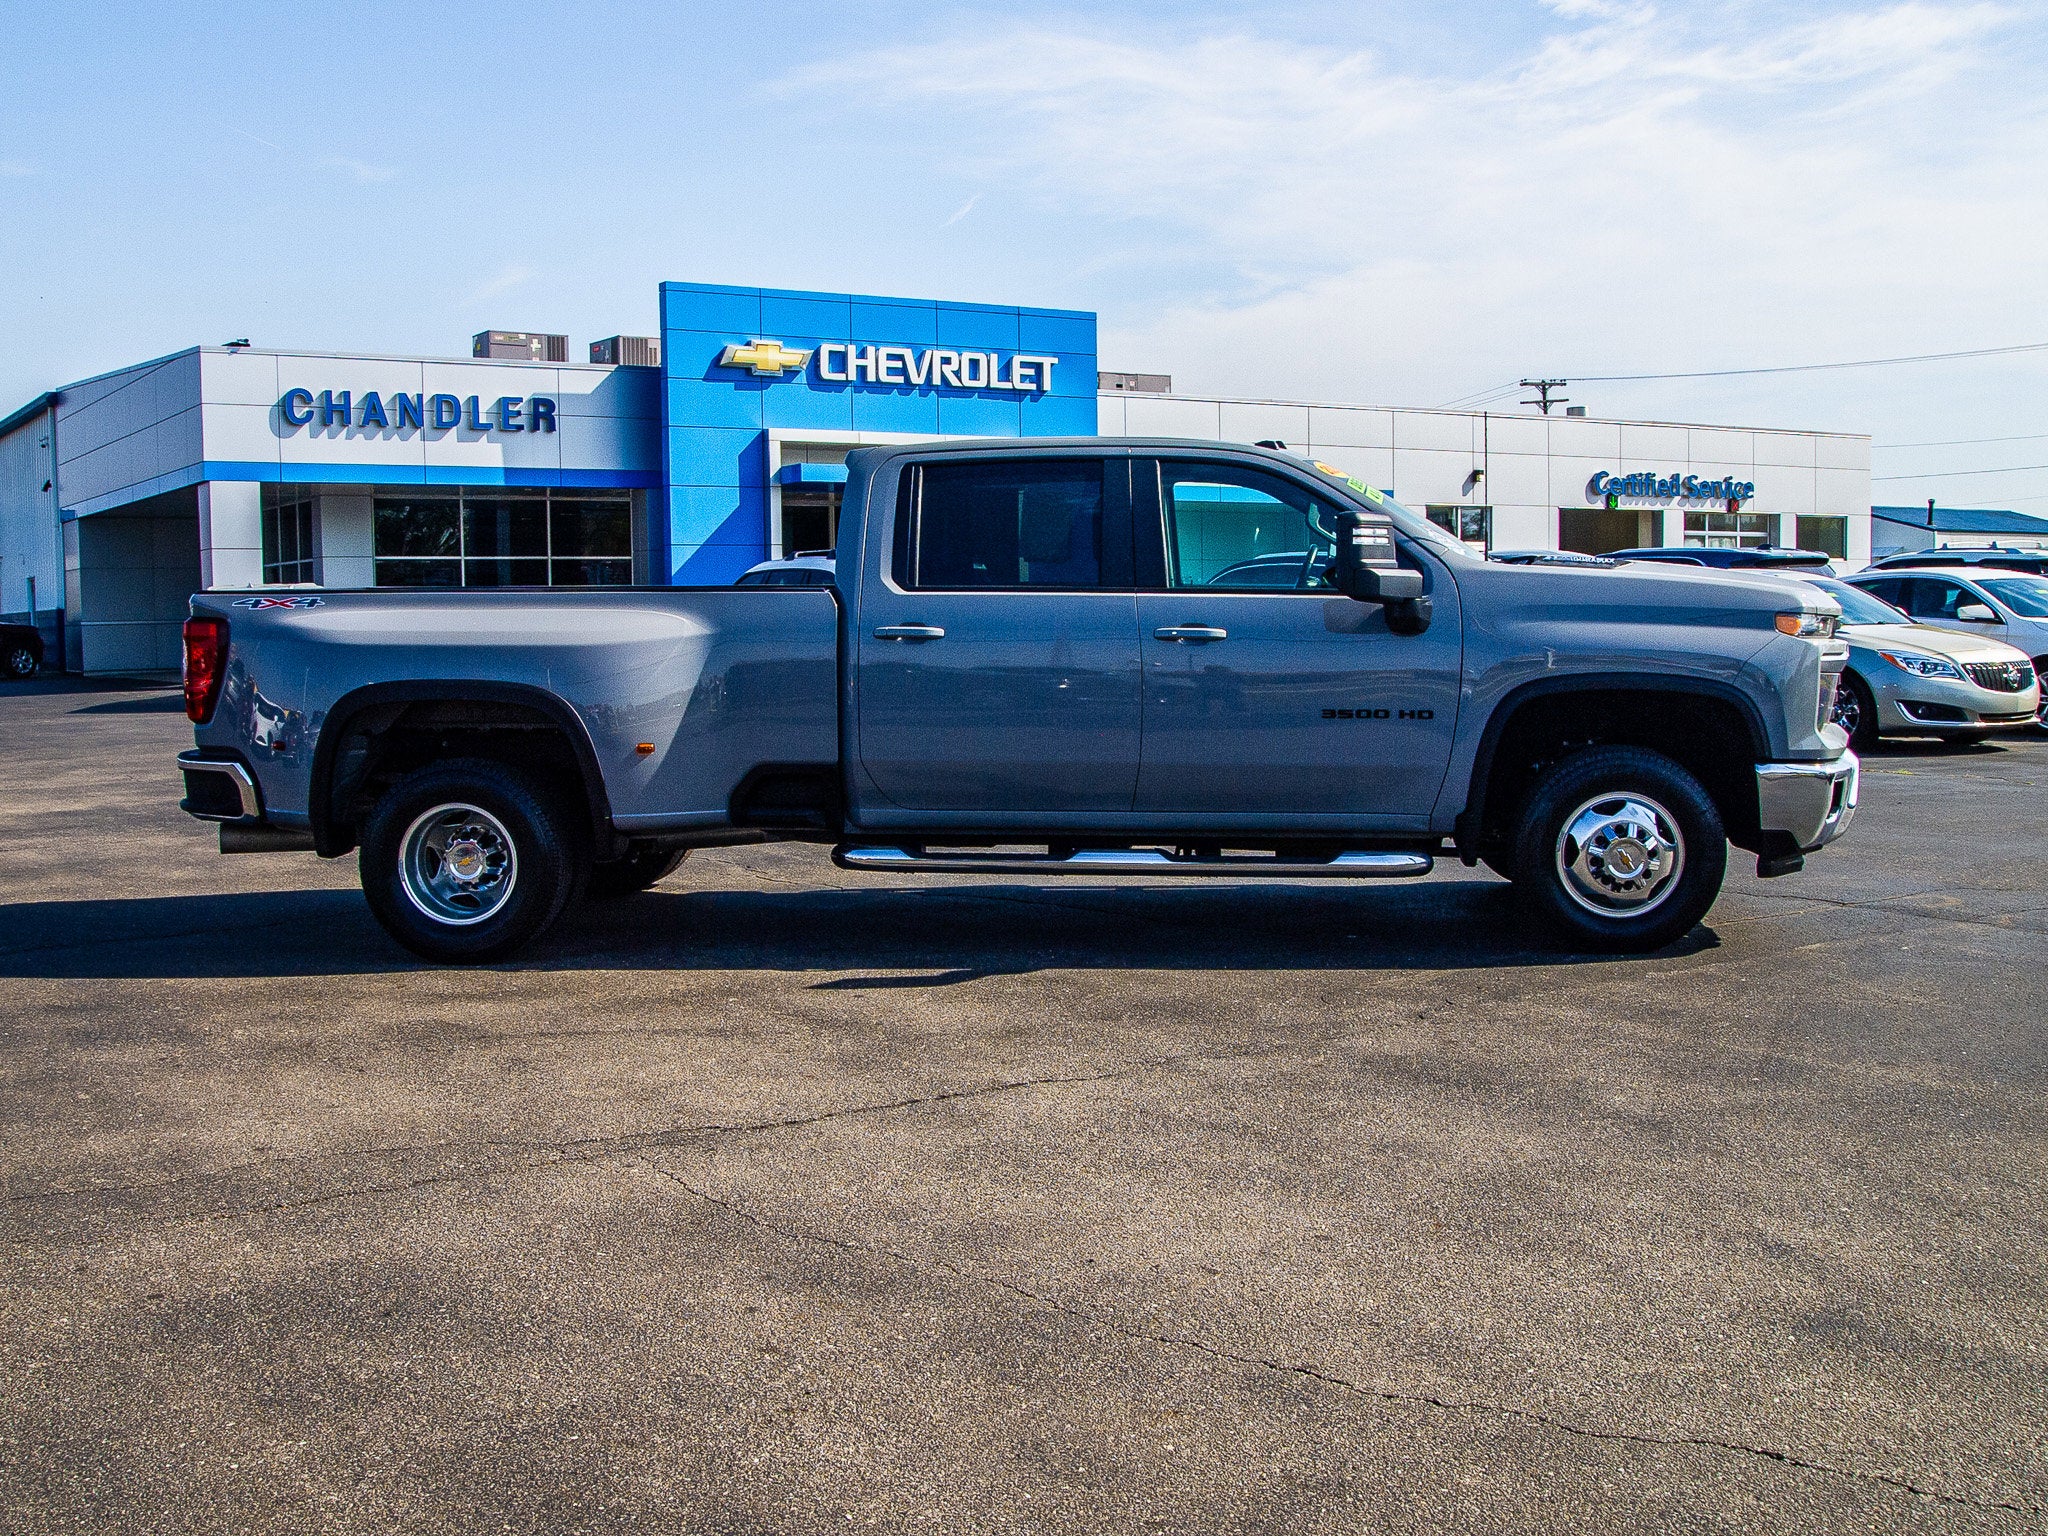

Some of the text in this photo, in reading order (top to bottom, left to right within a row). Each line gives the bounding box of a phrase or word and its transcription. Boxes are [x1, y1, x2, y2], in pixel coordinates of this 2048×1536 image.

[820, 343, 1058, 391] CHEVROLET
[284, 387, 557, 433] CHANDLER
[1595, 470, 1755, 499] Certified Service
[1321, 708, 1435, 720] 3500 HD
